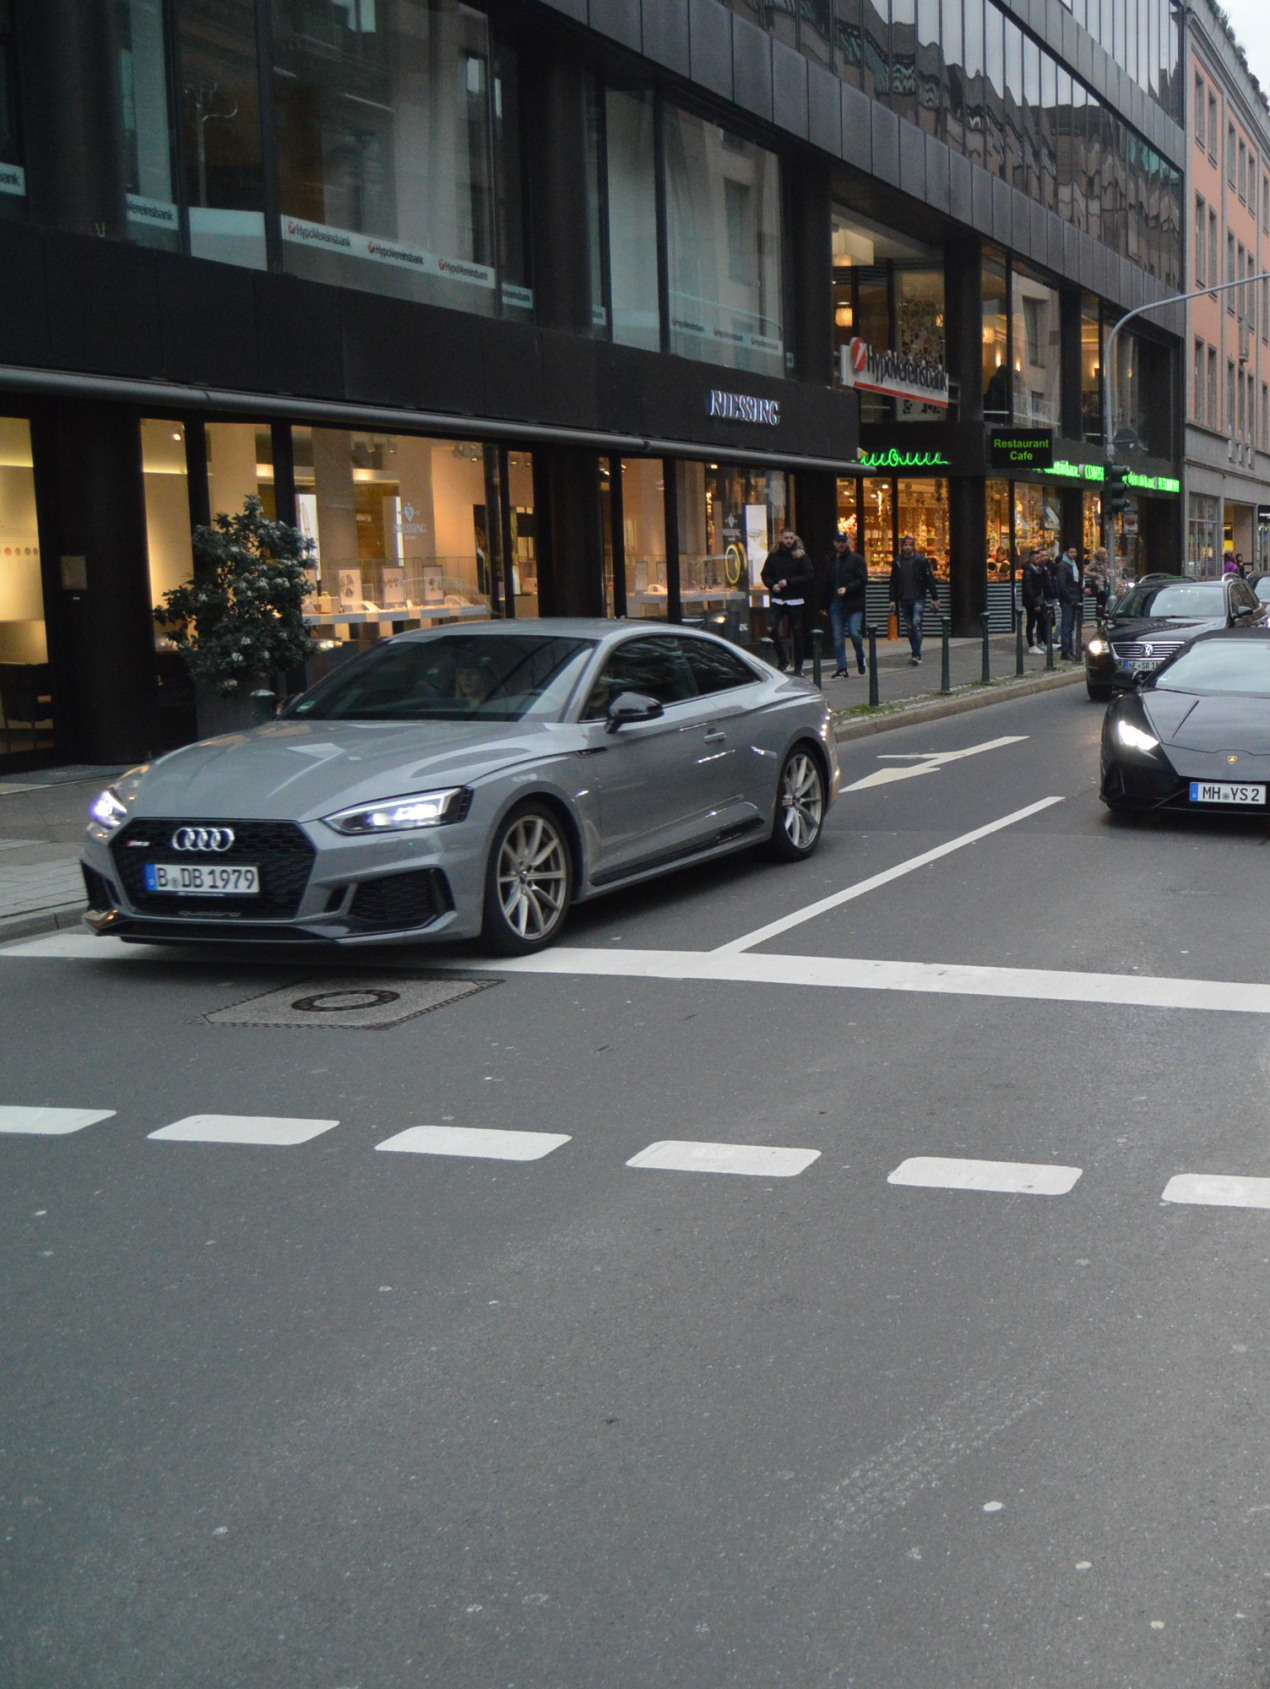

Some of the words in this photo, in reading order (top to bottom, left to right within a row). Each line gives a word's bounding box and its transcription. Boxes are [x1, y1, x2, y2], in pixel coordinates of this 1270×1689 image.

[296, 225, 351, 248] HypoVereinsbank
[375, 245, 424, 265] HypoVereinsbank
[710, 389, 781, 426] NIESSING
[994, 438, 1049, 448] Restaurant
[1010, 451, 1033, 460] Cafe
[1202, 786, 1221, 800] MH
[1230, 787, 1248, 801] YS
[1250, 788, 1260, 802] 2
[157, 868, 169, 888] B
[181, 869, 204, 888] DB
[208, 869, 255, 889] 1979
